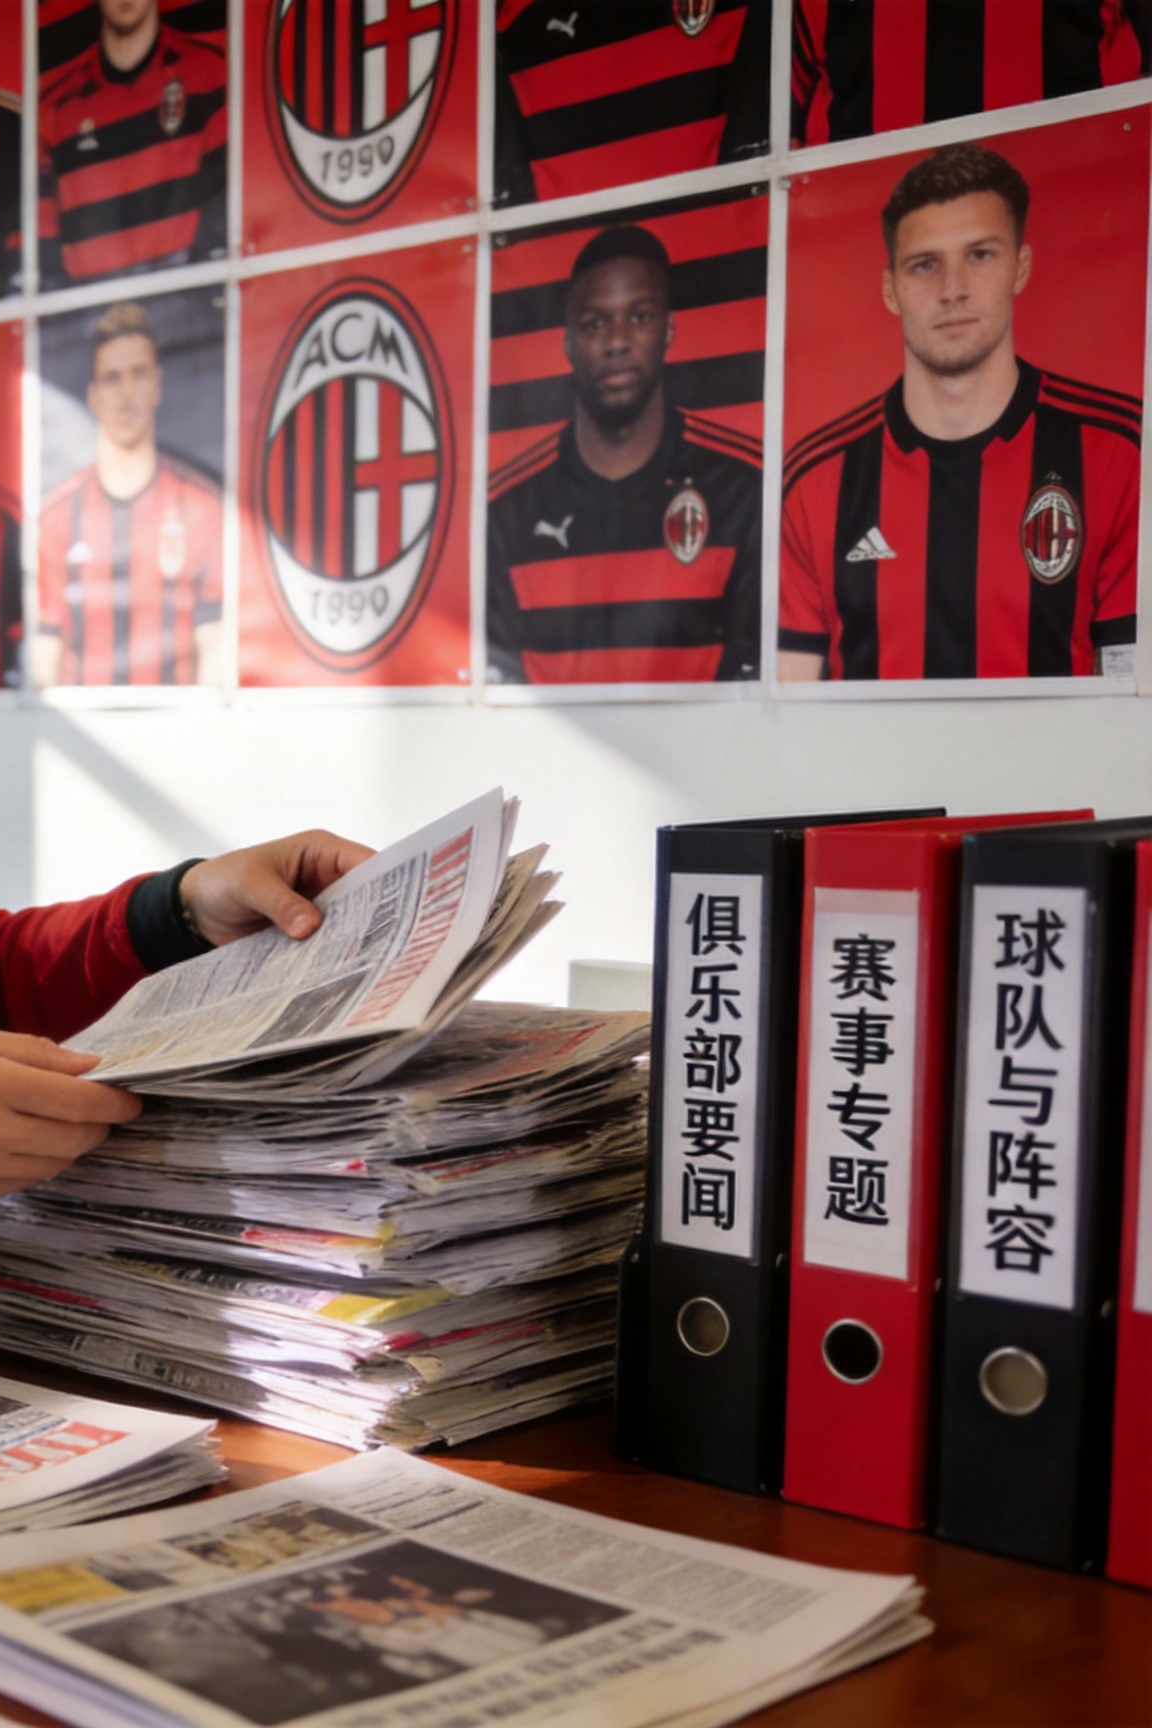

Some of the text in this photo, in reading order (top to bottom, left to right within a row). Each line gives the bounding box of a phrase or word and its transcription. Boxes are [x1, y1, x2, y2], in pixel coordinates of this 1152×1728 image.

[320, 134, 395, 183] 1990
[295, 312, 408, 389] ACM
[311, 584, 389, 626] 1990
[681, 893, 746, 1231] 俱乐部要闻
[824, 933, 896, 1226] 赛事专题
[985, 908, 1066, 1276] 球队与阵容
